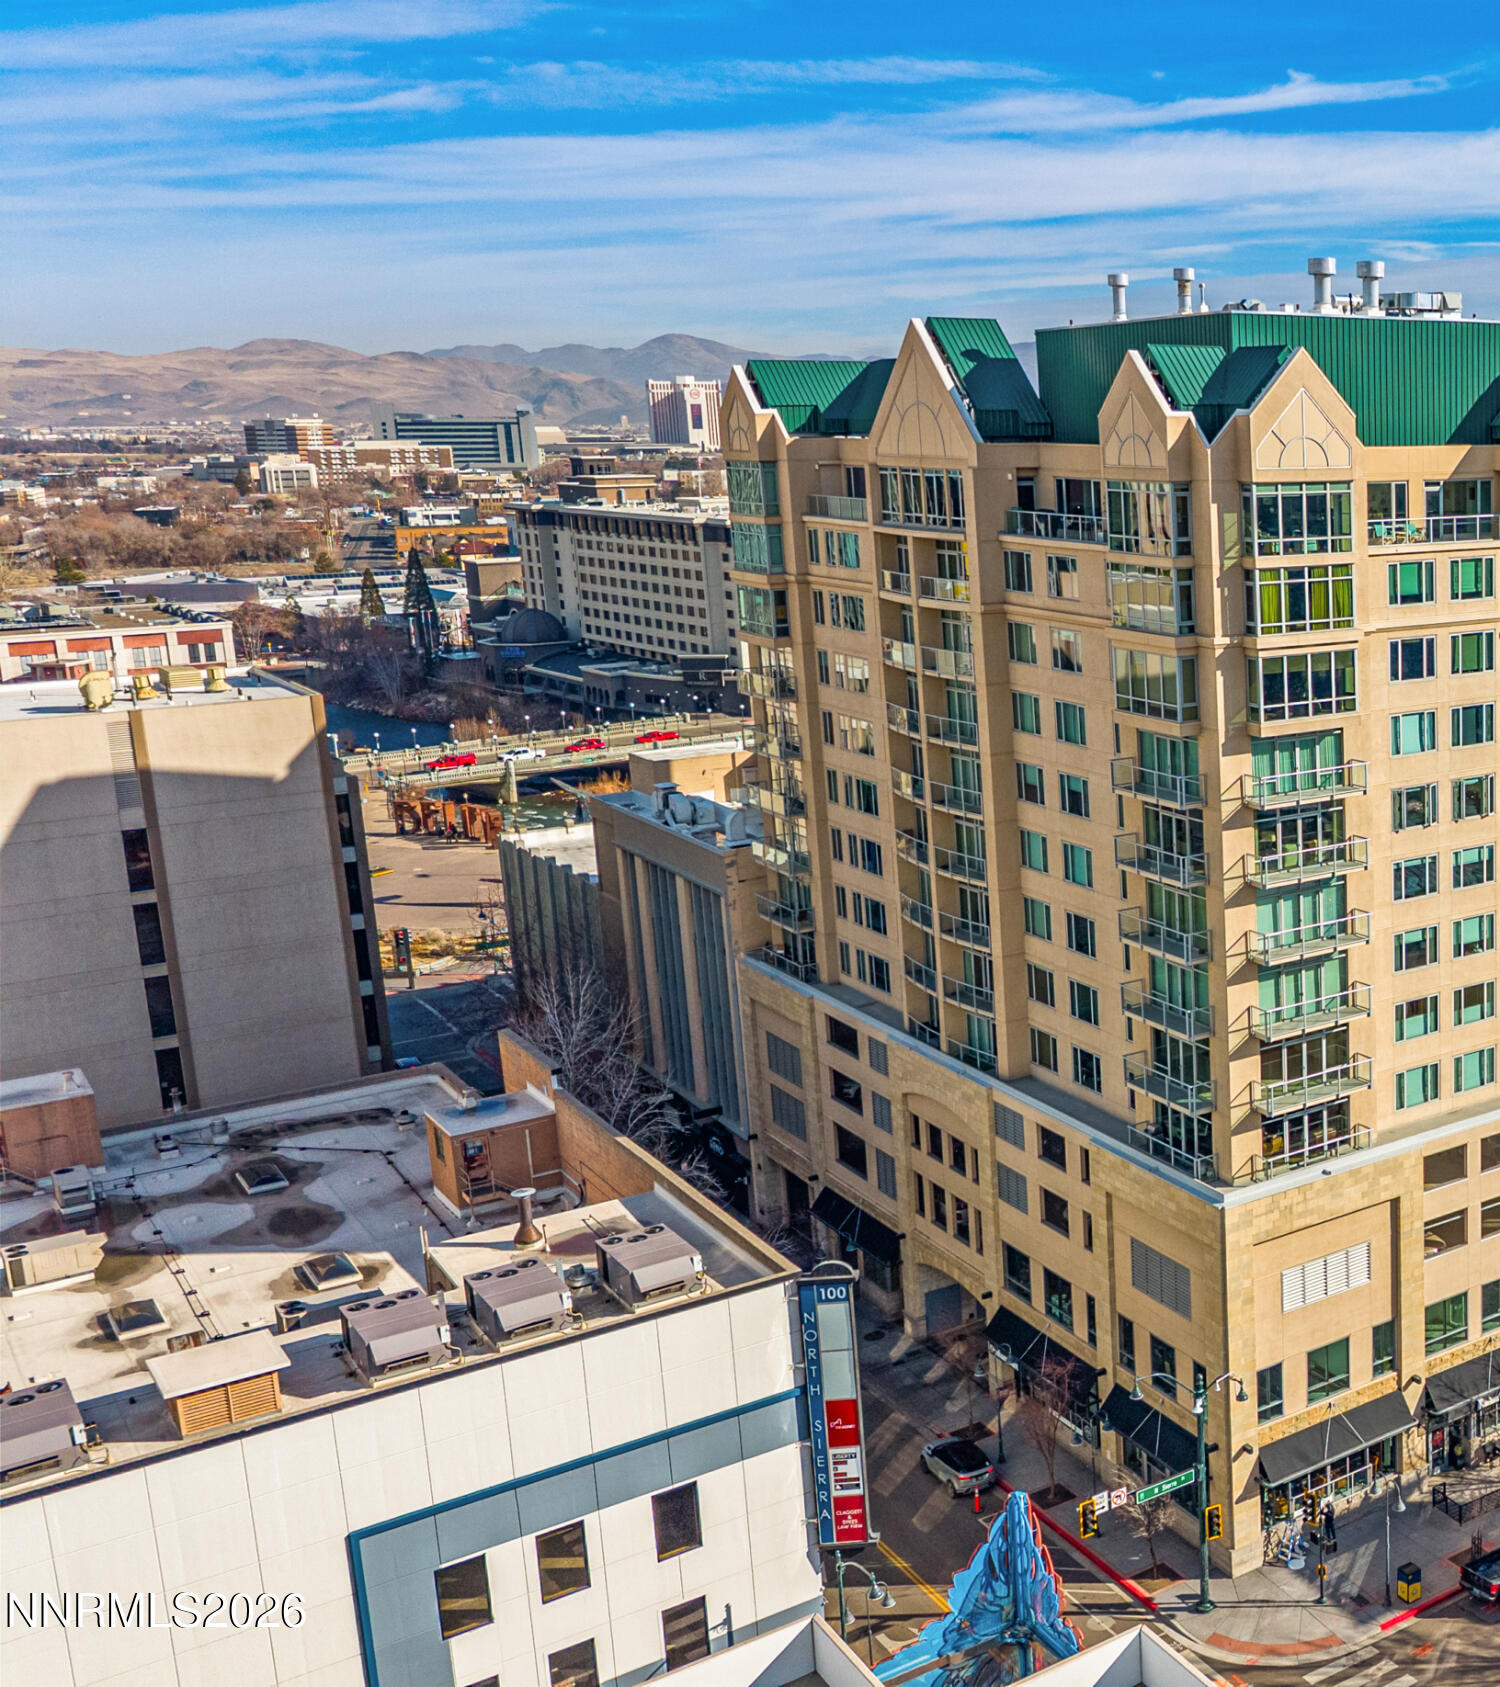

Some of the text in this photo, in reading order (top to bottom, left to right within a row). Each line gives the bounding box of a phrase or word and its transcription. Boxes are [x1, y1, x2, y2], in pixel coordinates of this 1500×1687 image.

[820, 1287, 846, 1300] 100
[804, 1312, 831, 1520] NORTH SIERRA
[1162, 1481, 1177, 1491] Sierra
